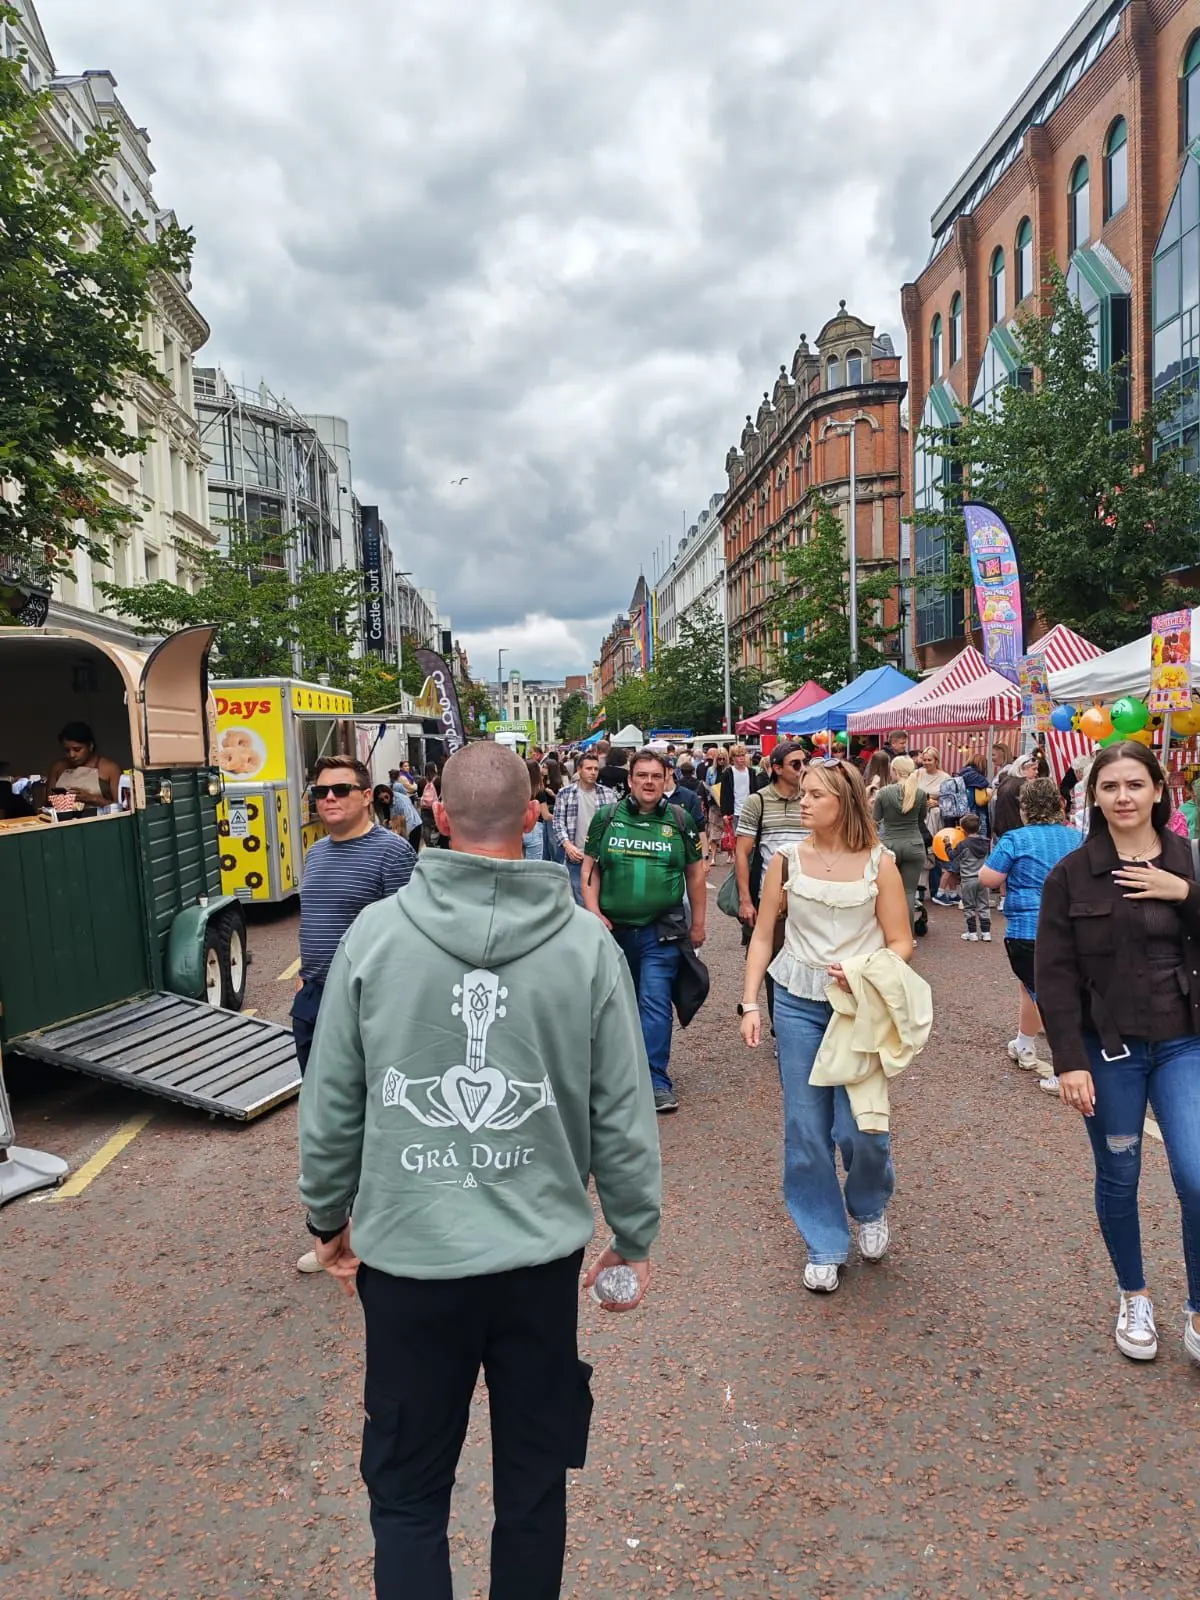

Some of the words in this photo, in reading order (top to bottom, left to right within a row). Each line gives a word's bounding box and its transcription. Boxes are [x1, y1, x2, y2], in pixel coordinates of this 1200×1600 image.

[215, 698, 271, 719] Days
[608, 836, 672, 852] DEVENISH
[401, 1141, 459, 1174] Grá
[470, 1143, 535, 1170] Duit
